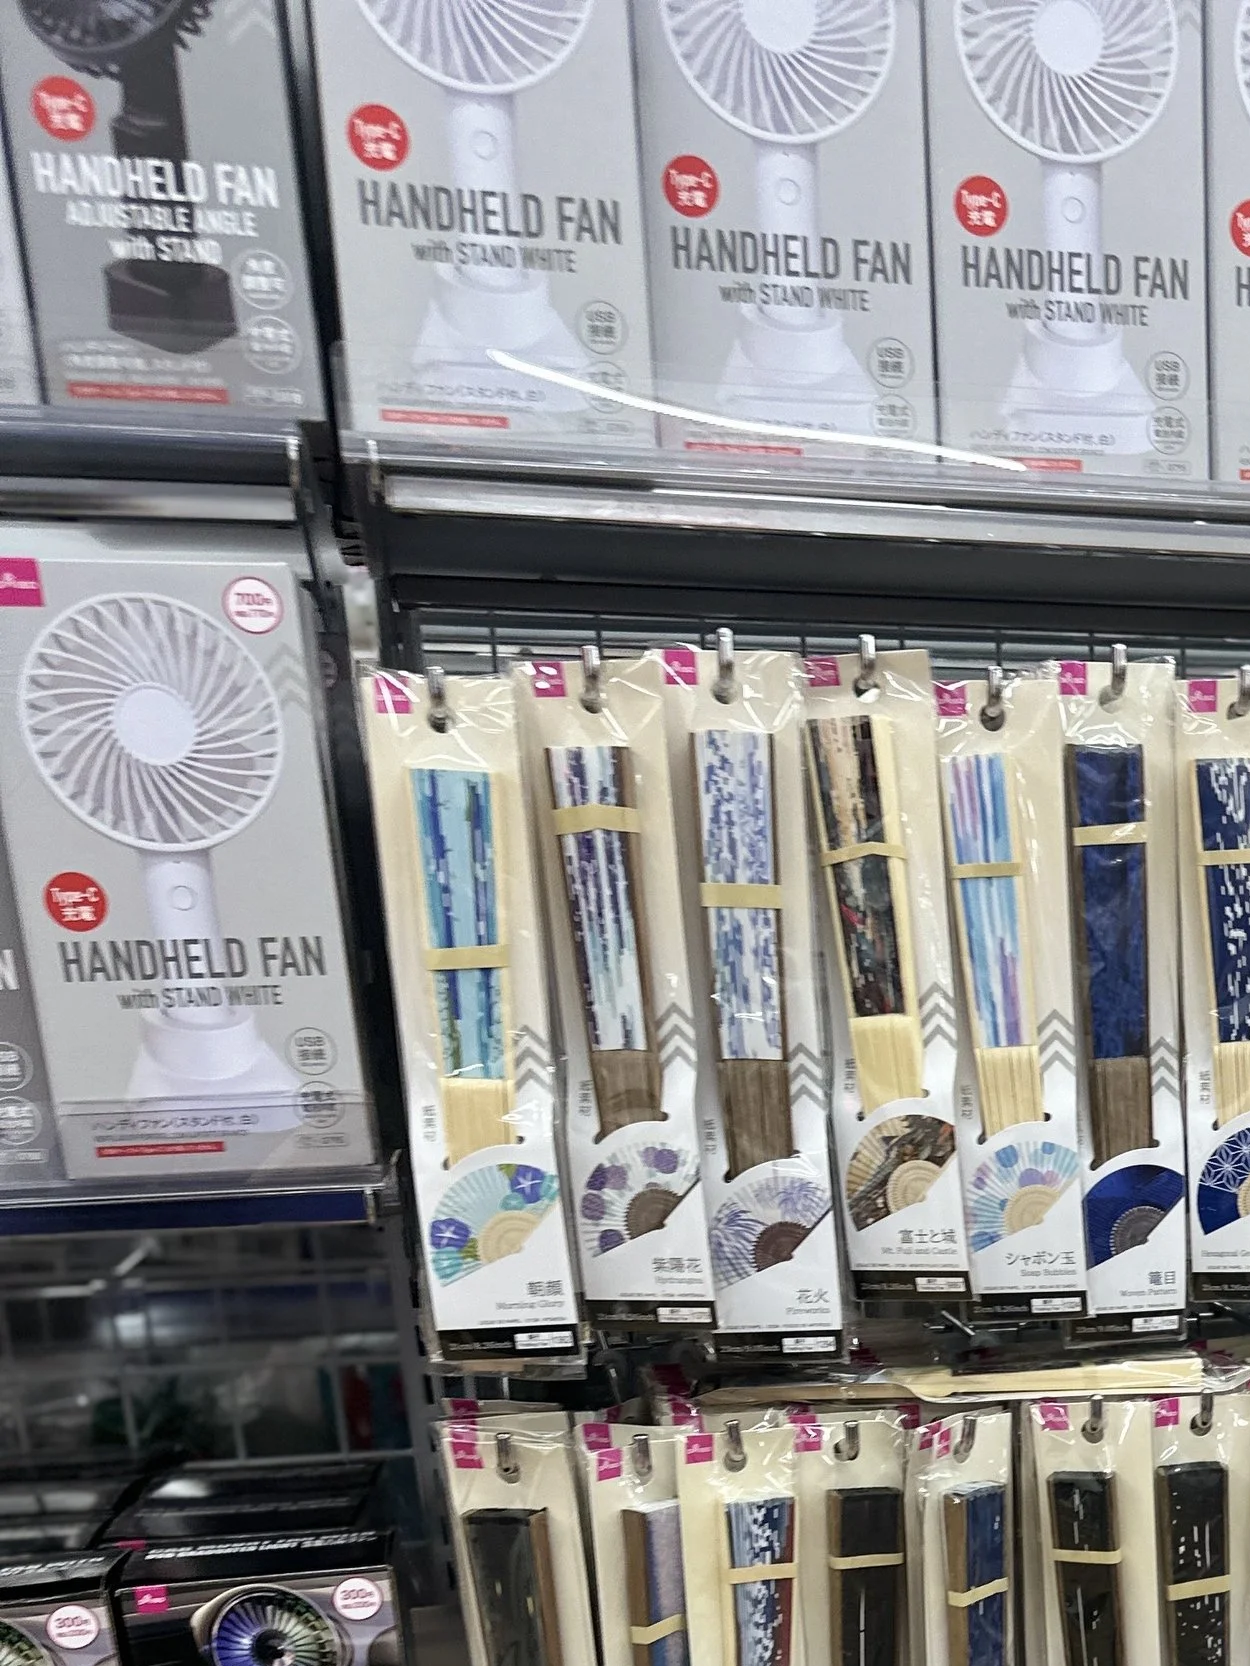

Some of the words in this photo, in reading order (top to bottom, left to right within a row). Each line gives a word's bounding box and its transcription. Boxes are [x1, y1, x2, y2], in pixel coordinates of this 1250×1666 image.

[32, 153, 209, 204] HANDHELD
[213, 159, 280, 209] FAN
[195, 205, 258, 238] ANGLE
[358, 180, 545, 240] HANDHELD
[557, 196, 623, 246] FAN
[106, 236, 155, 261] with
[156, 238, 223, 264] STAND
[411, 239, 454, 267] with
[455, 242, 516, 272] STAND
[518, 246, 577, 274] WHITE
[670, 225, 841, 282] HANDHELD
[853, 240, 912, 286] FAN
[961, 244, 1123, 298] HANDHELD
[1133, 256, 1190, 301] FAN
[719, 281, 754, 303] with
[759, 284, 813, 309] STAND
[818, 287, 871, 313] WHITE
[1006, 299, 1040, 322] with
[1045, 300, 1096, 325] STAND
[1100, 302, 1149, 328] WHITE
[58, 937, 248, 983] HANDHELD
[258, 936, 328, 977] FAN
[161, 986, 224, 1008] STAND
[226, 985, 283, 1006] WHITE
[1005, 1251, 1077, 1267] シャボン玉
[797, 1287, 831, 1305] 花火
